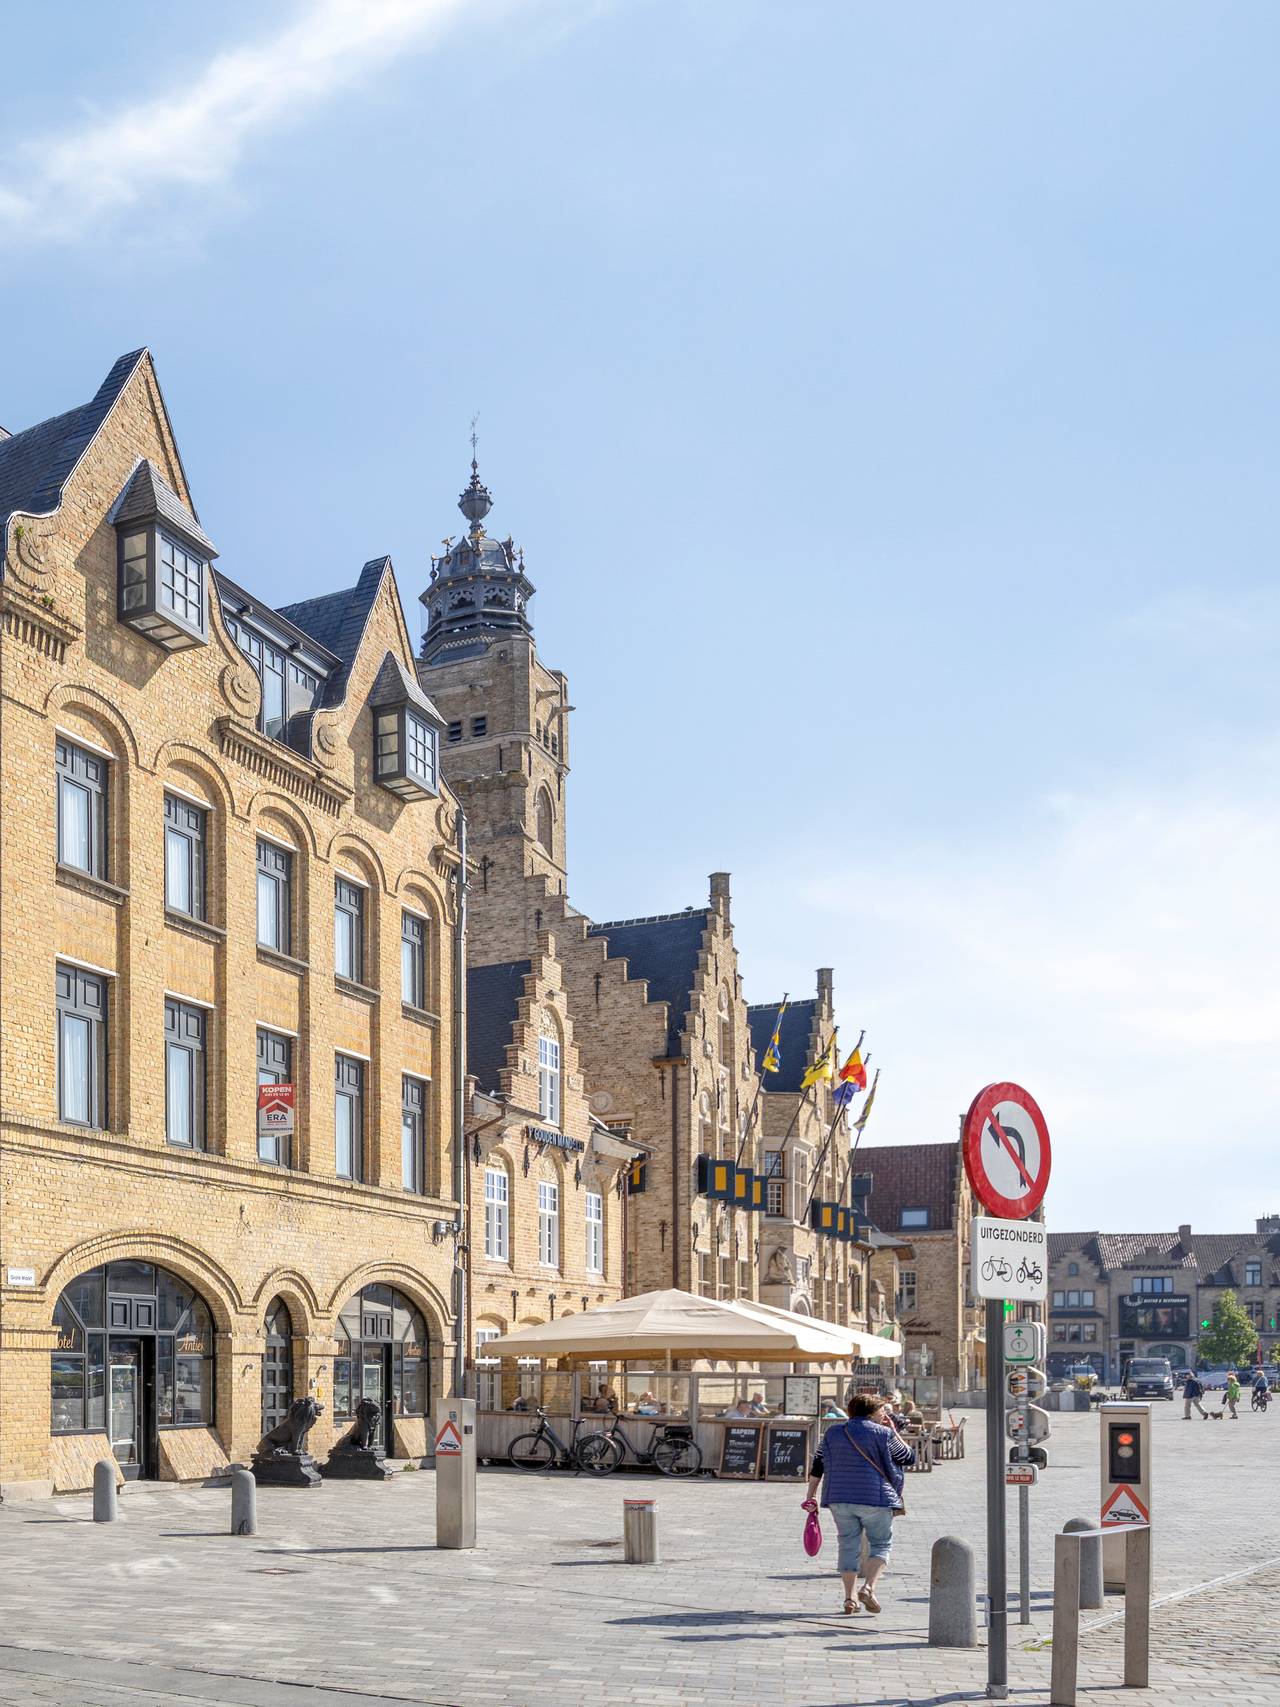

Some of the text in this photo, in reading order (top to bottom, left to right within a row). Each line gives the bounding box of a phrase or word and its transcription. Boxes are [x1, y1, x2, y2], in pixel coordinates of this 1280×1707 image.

[534, 1128, 557, 1145] GOUDEN
[980, 1227, 1044, 1244] UITGEZONDERD
[58, 1328, 75, 1349] otel
